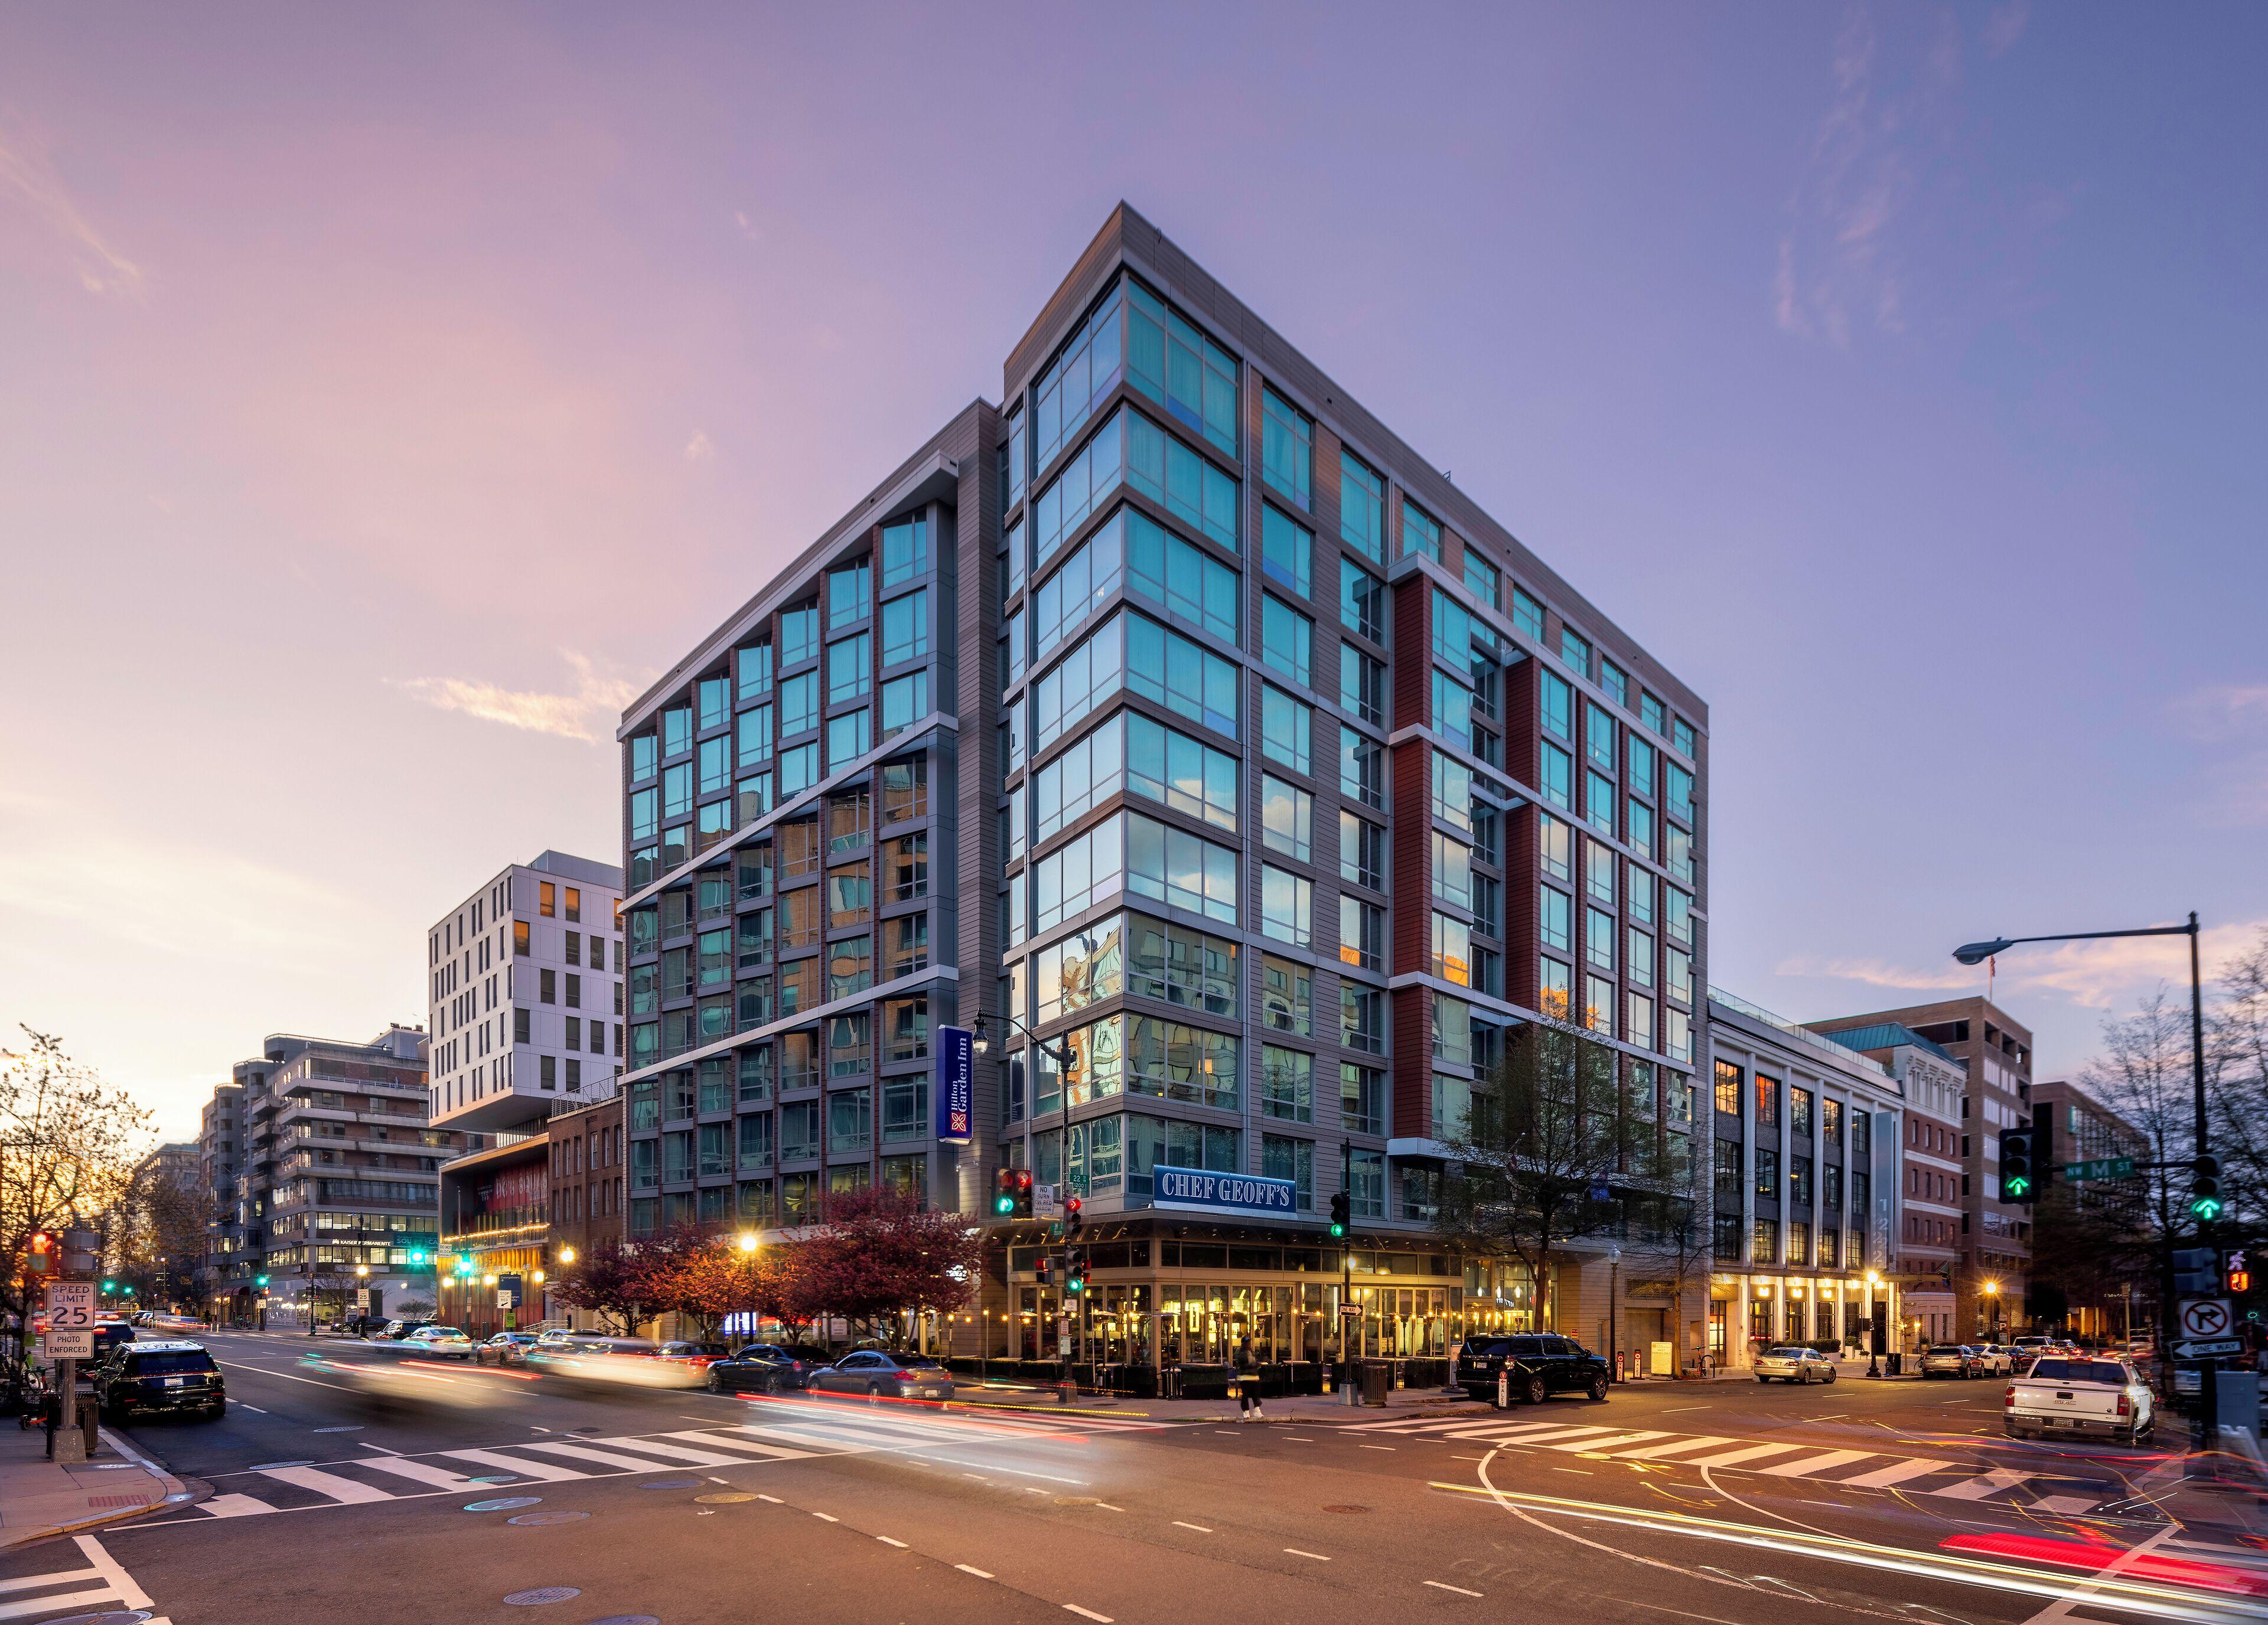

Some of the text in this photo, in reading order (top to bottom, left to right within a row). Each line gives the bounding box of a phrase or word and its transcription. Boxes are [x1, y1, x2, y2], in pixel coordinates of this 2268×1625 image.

[957, 1037, 967, 1112] Garden Inn
[2067, 1161, 2131, 1177] NW M ST
[1162, 1173, 1289, 1206] CHEF GEOFF'S
[53, 1306, 87, 1324] 25
[2193, 1345, 2213, 1353] ONE
